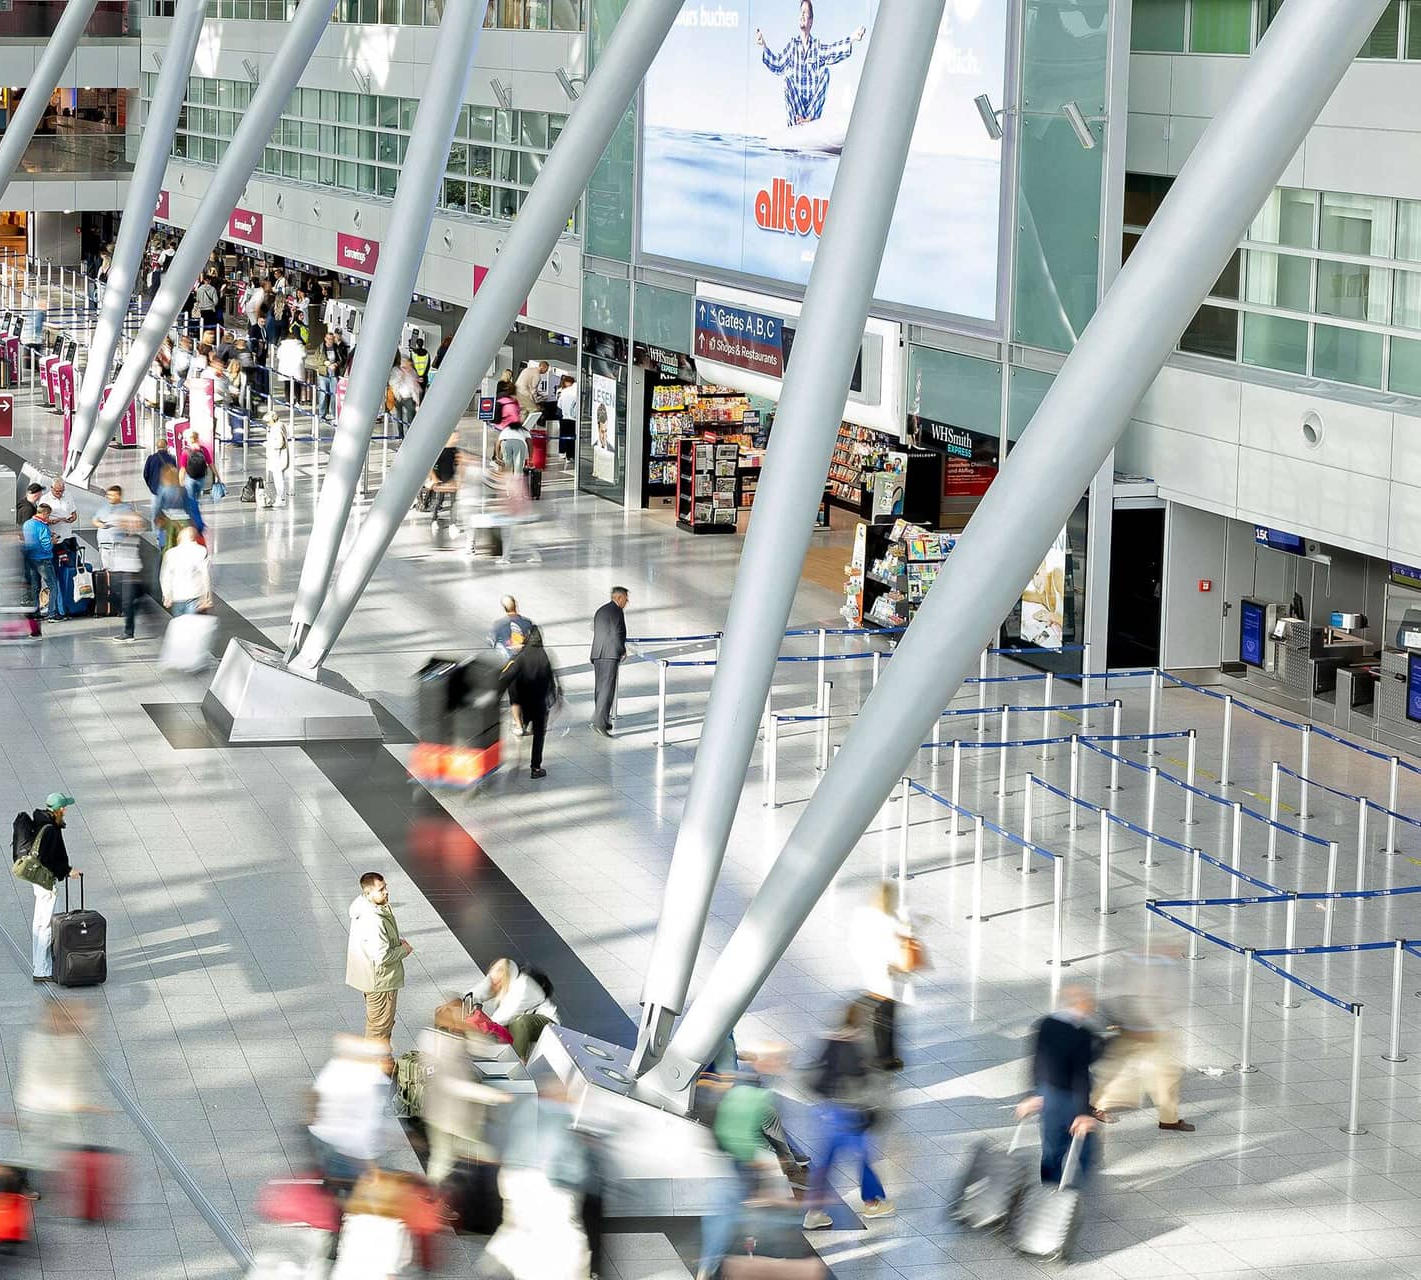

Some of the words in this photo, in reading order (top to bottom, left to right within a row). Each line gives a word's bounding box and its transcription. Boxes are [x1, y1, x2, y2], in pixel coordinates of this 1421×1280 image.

[717, 308, 745, 331] Gates
[745, 315, 776, 340] A,B,C
[716, 338, 736, 356] Shops
[735, 344, 742, 357] &
[741, 345, 778, 366] Restaurants
[593, 387, 616, 408] LESEN
[931, 423, 973, 448] WHSmith
[947, 443, 973, 458] EXPRESS
